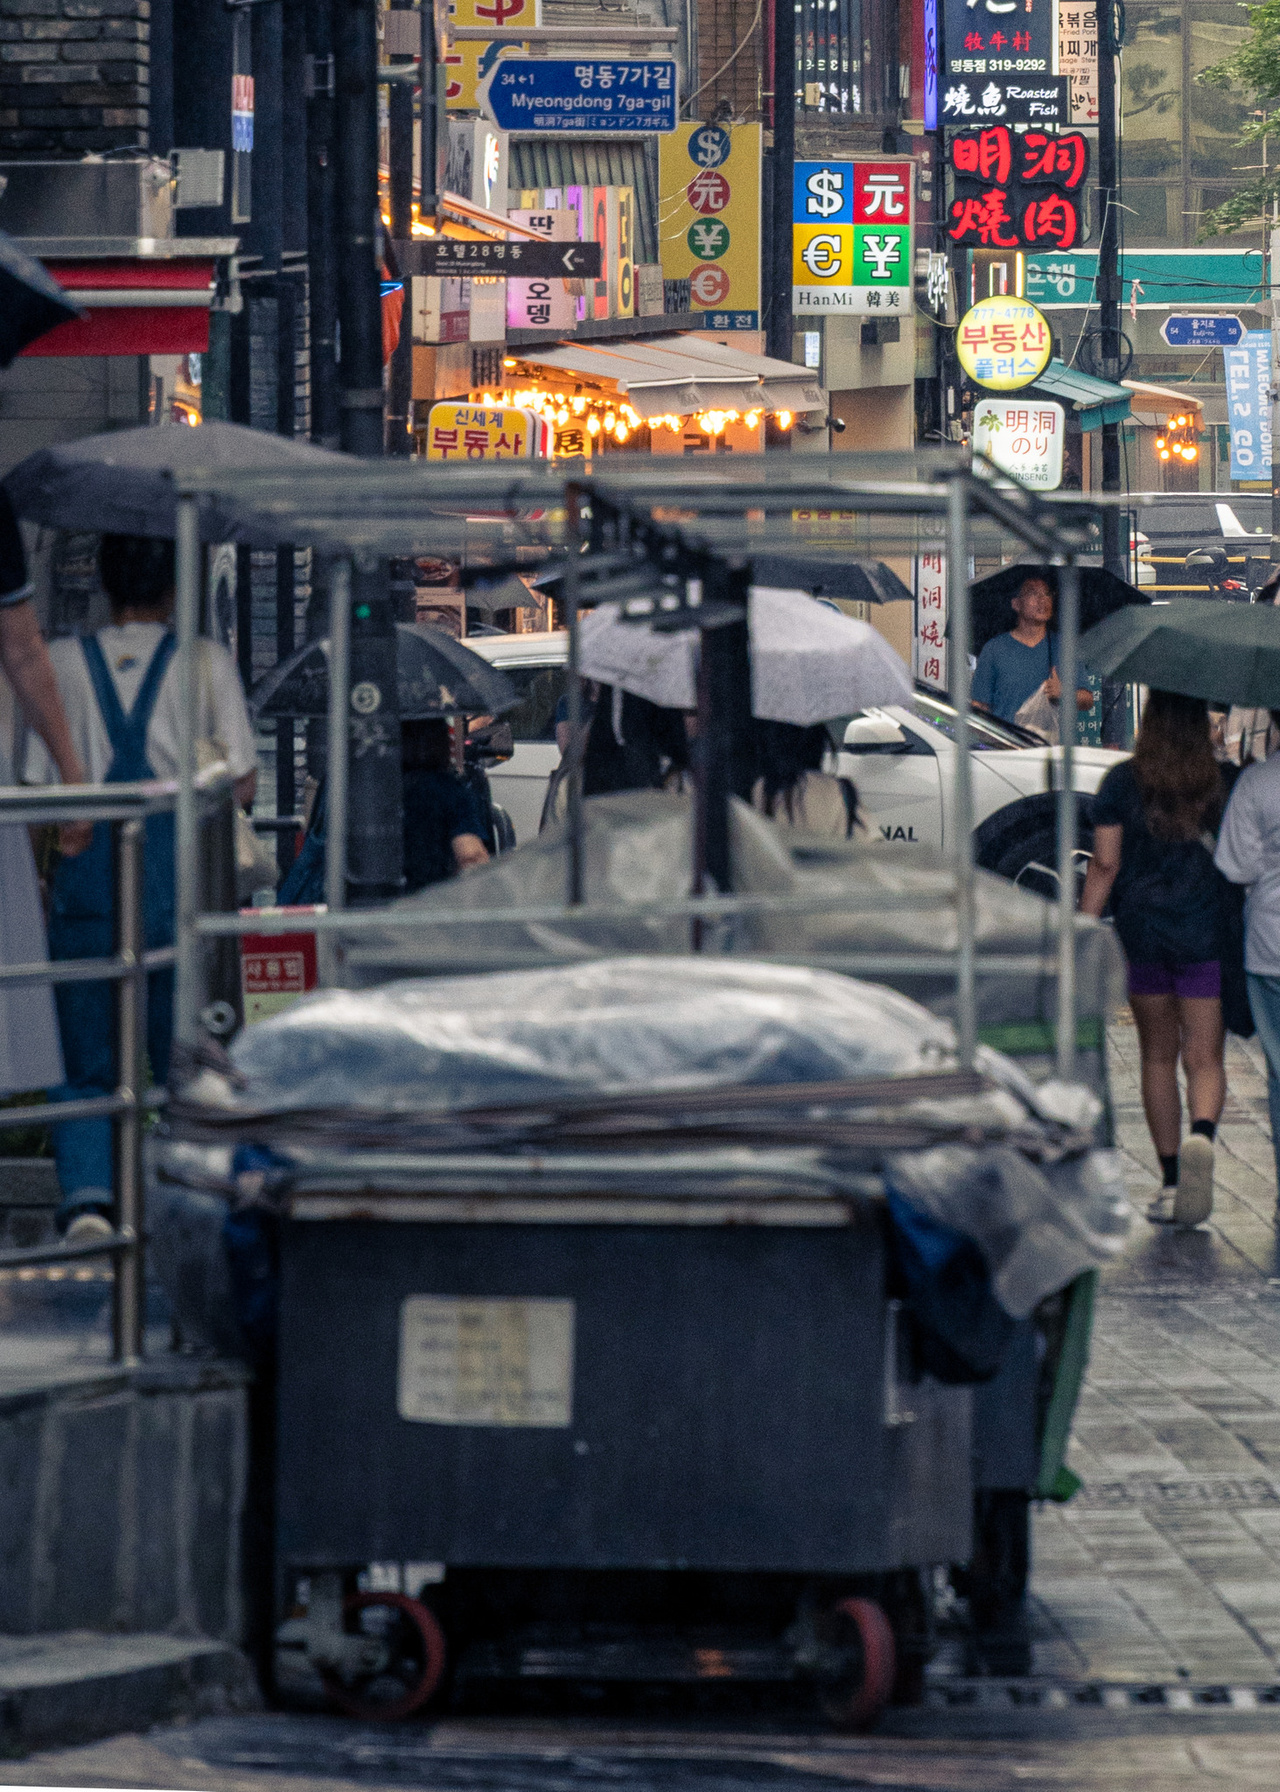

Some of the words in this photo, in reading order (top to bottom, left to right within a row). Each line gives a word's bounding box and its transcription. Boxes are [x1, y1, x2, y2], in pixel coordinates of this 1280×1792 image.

[951, 58, 987, 74] 명동점
[989, 58, 1046, 73] 319-9292
[501, 74, 515, 85] 34
[575, 65, 671, 89] 명동7가길
[512, 93, 612, 111] Myeongdong
[618, 94, 671, 112] 7ga-gil
[1006, 87, 1058, 100] Roasted
[1029, 102, 1059, 117] Fish
[953, 126, 1087, 188] 明洞
[863, 175, 905, 216] 元
[798, 292, 852, 306] HanMi
[866, 291, 900, 307] 韓美
[712, 314, 752, 328] 환전
[973, 307, 1034, 319] 777-4778
[1191, 319, 1216, 330] 을지로
[961, 323, 1045, 354] 부동산
[974, 358, 1037, 379] 플러스
[455, 408, 504, 428] 신세계
[1006, 411, 1055, 434] 明洞
[1012, 437, 1048, 456] のり
